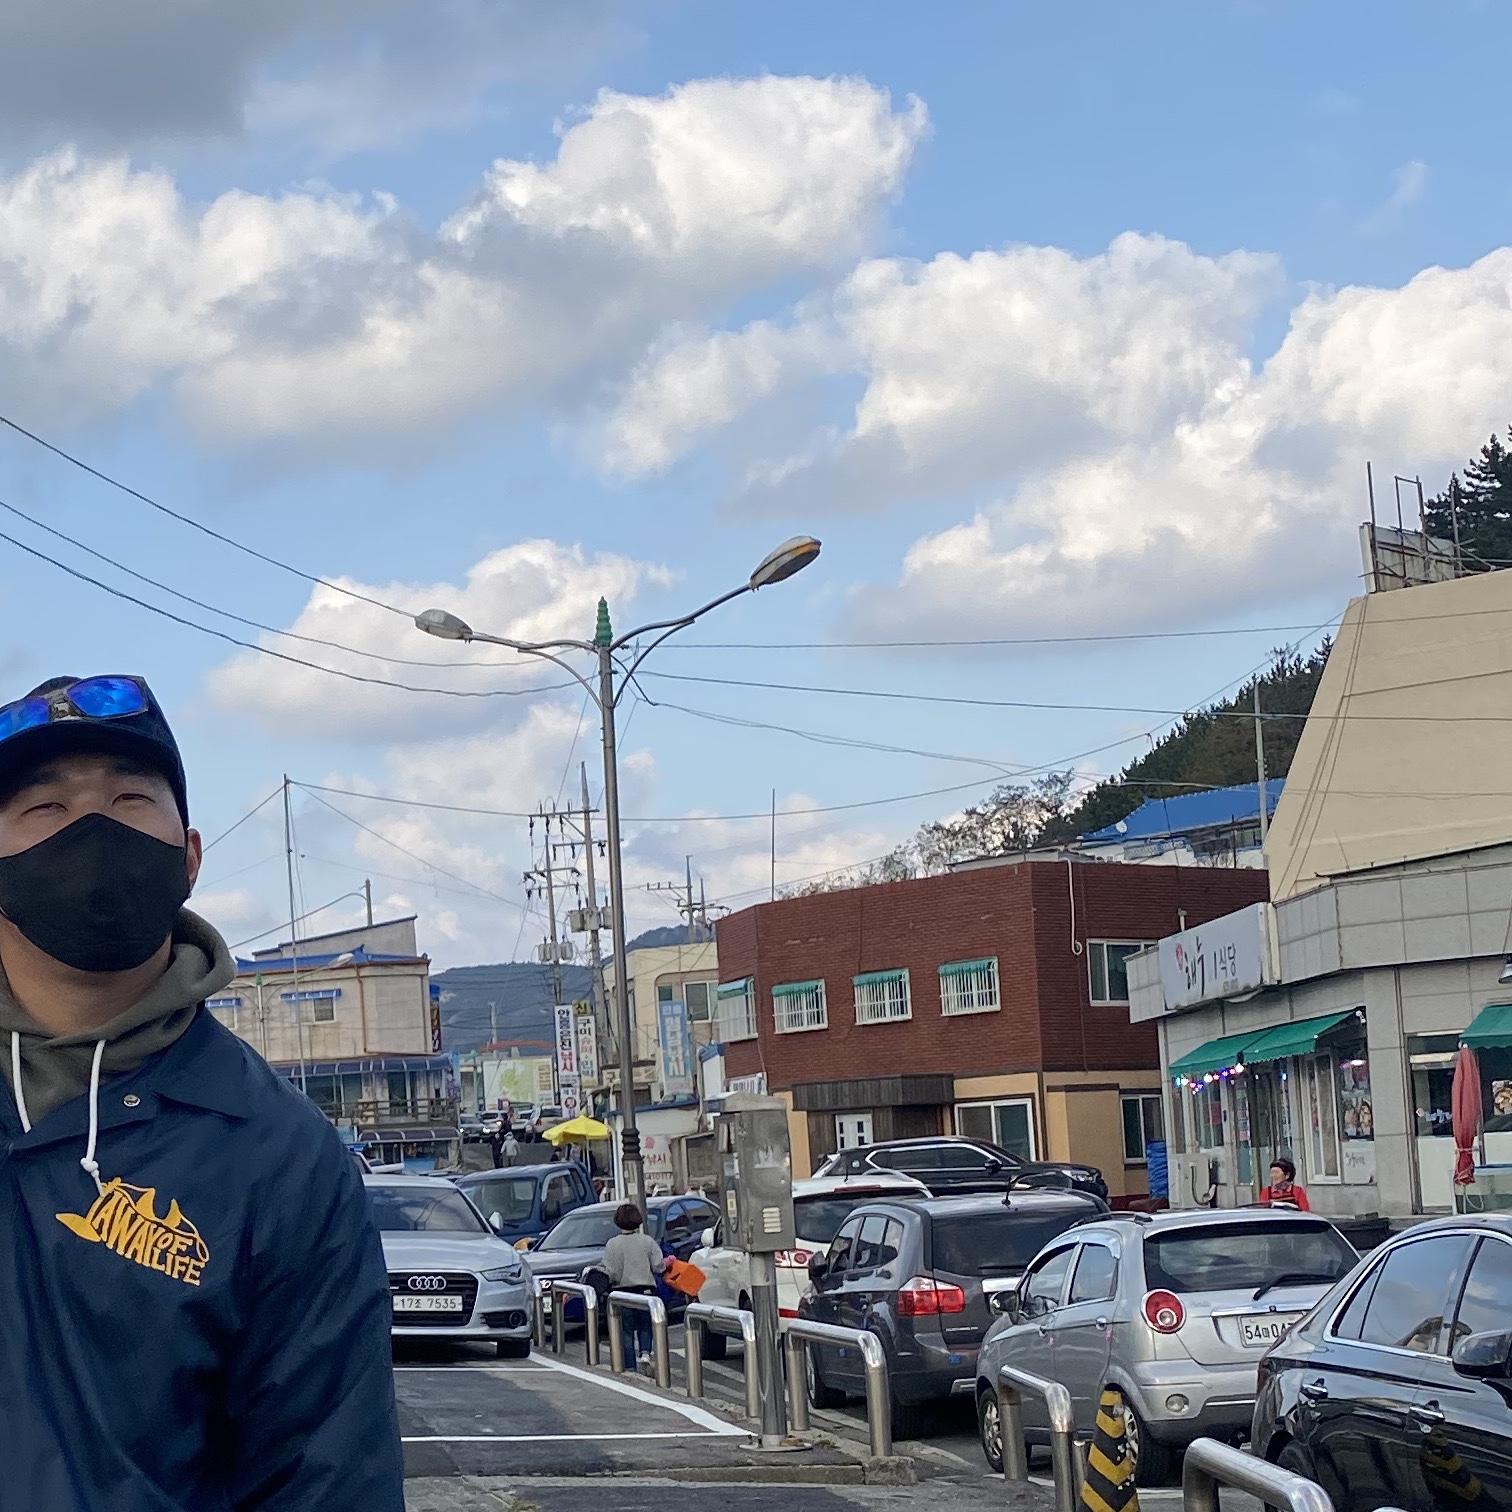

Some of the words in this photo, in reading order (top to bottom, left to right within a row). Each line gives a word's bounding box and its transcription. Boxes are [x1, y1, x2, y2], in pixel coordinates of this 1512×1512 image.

[642, 1153, 667, 1166] 낚시
[156, 1232, 193, 1255] OF
[150, 1246, 206, 1287] LIFE
[427, 1298, 457, 1309] 7535
